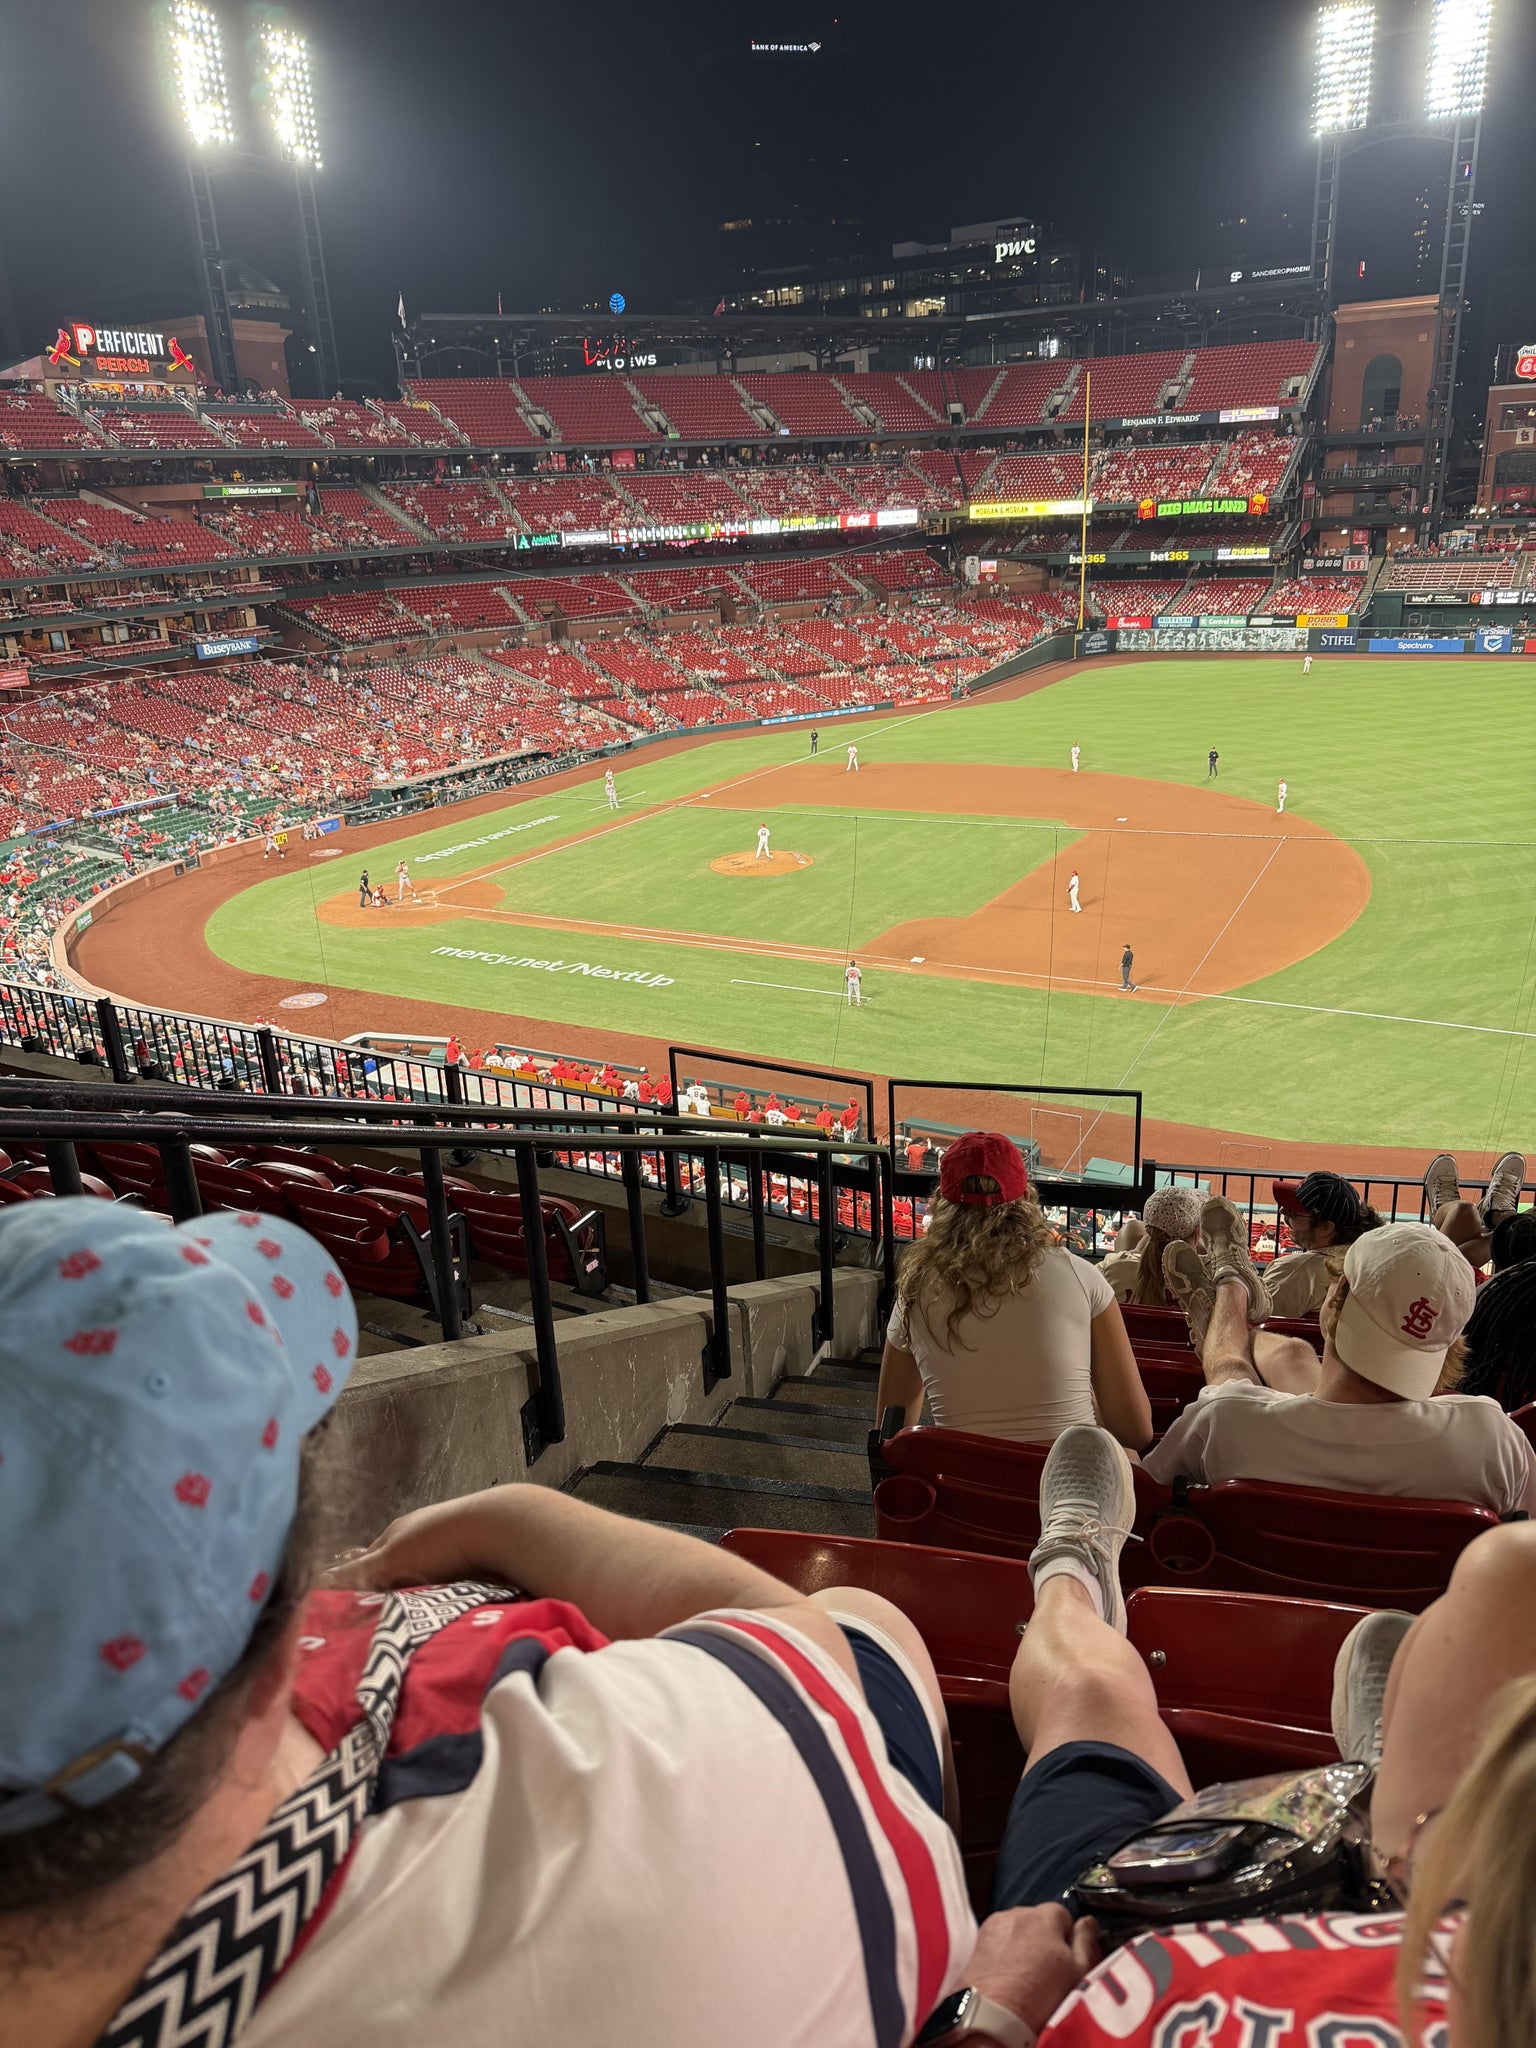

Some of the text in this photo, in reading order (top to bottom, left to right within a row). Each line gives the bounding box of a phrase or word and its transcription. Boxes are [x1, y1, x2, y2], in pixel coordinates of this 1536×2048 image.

[995, 239, 1036, 263] pwc
[1251, 265, 1311, 278] SANDBERGPHOENI
[72, 323, 165, 356] PERFICIENT
[96, 356, 150, 373] PERCH
[1121, 418, 1157, 427] BENJAMIN
[1165, 414, 1200, 424] EDWARDS
[1182, 501, 1213, 514] MAC
[1213, 500, 1247, 514] LAND
[1150, 551, 1189, 562] bet365
[1479, 627, 1509, 635] CarShield
[1320, 634, 1356, 646] STIFEL
[1398, 641, 1431, 649] Spectrum
[430, 945, 675, 988] mercy.net/NextUp
